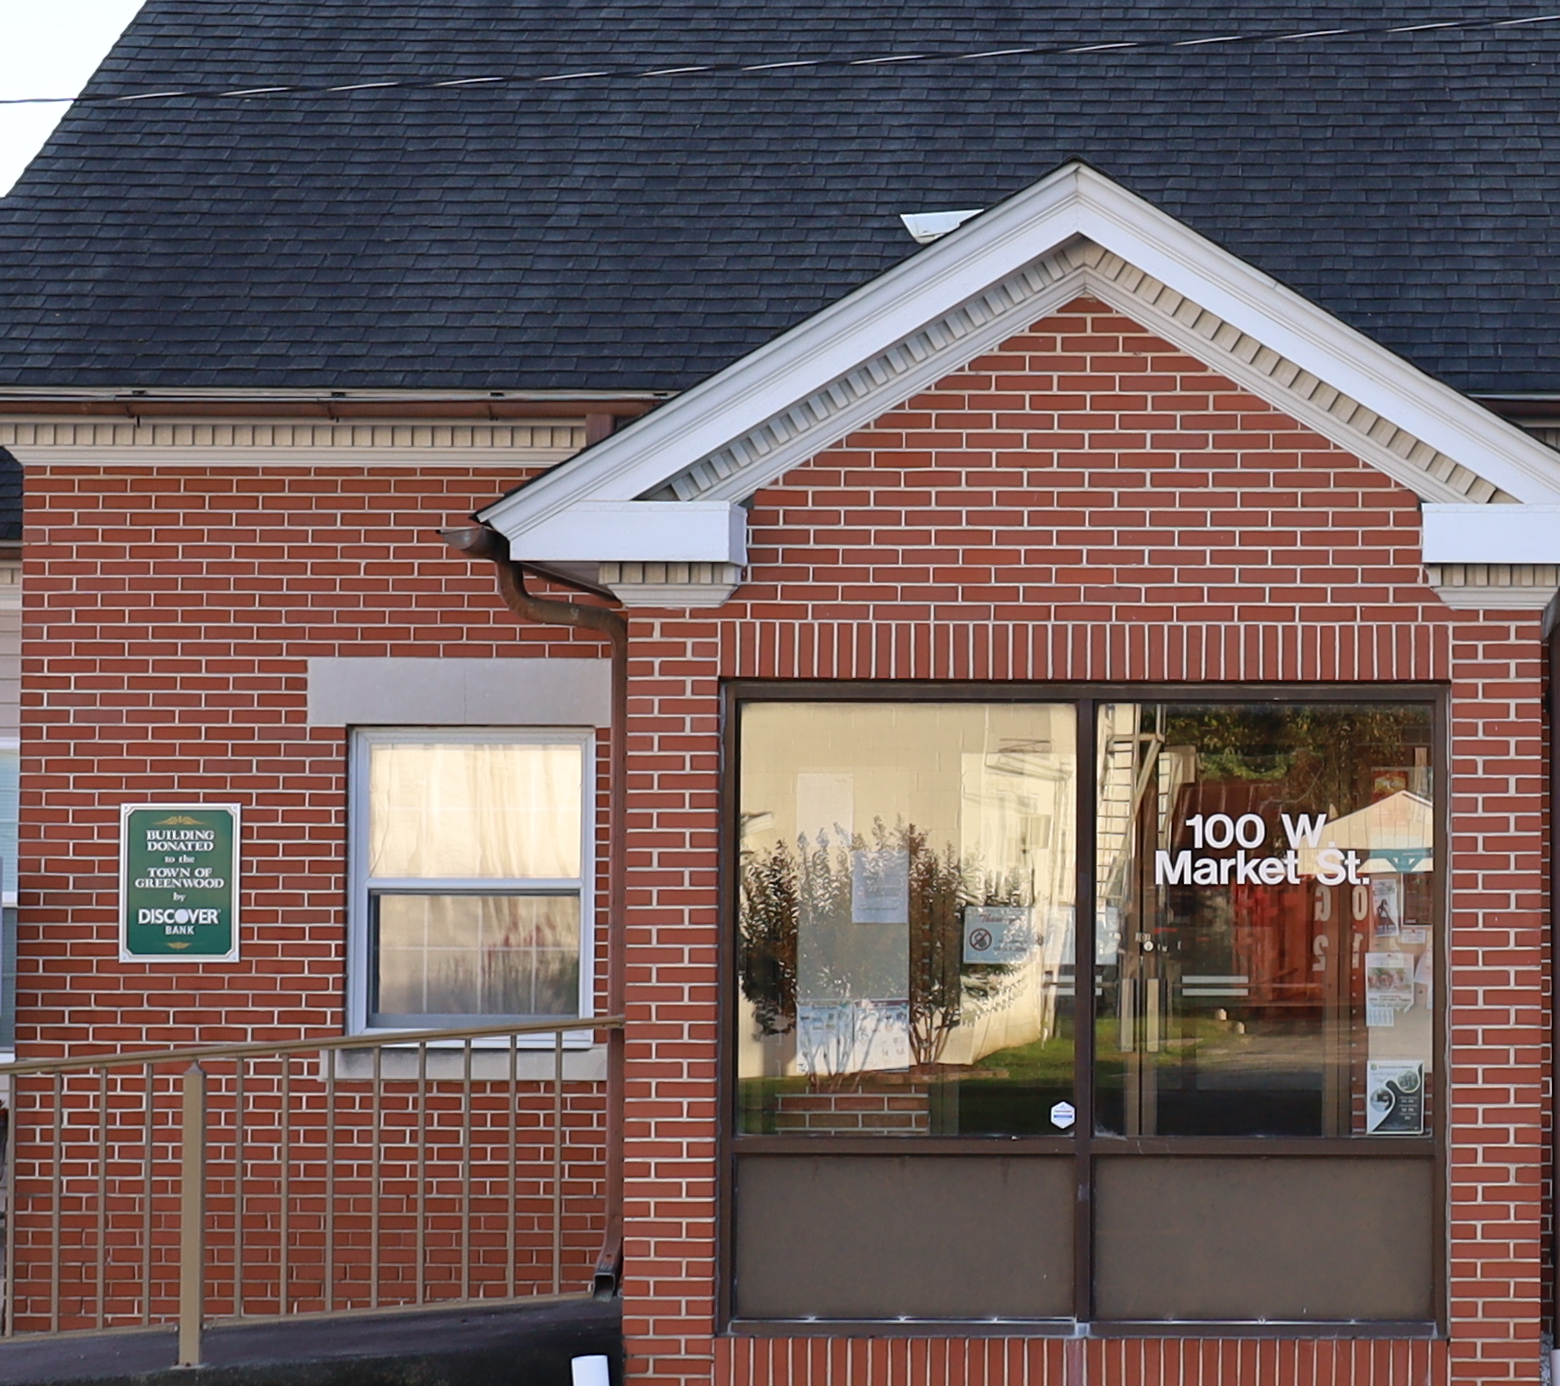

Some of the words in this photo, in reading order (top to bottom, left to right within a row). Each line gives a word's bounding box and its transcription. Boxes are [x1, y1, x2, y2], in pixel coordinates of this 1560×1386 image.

[146, 829, 214, 840] BUILDING
[1185, 813, 1266, 850] 100
[1281, 813, 1336, 849] W.
[146, 841, 213, 851] DONATED
[164, 855, 175, 863] to
[178, 854, 195, 863] the
[147, 867, 190, 877] TOWN
[194, 867, 212, 877] OF
[1155, 849, 1301, 886] Market
[1315, 848, 1371, 886] St.
[135, 878, 224, 888] GREENWOOD
[172, 891, 185, 902] by
[138, 908, 218, 924] DISCOVER
[165, 925, 194, 935] BANK
